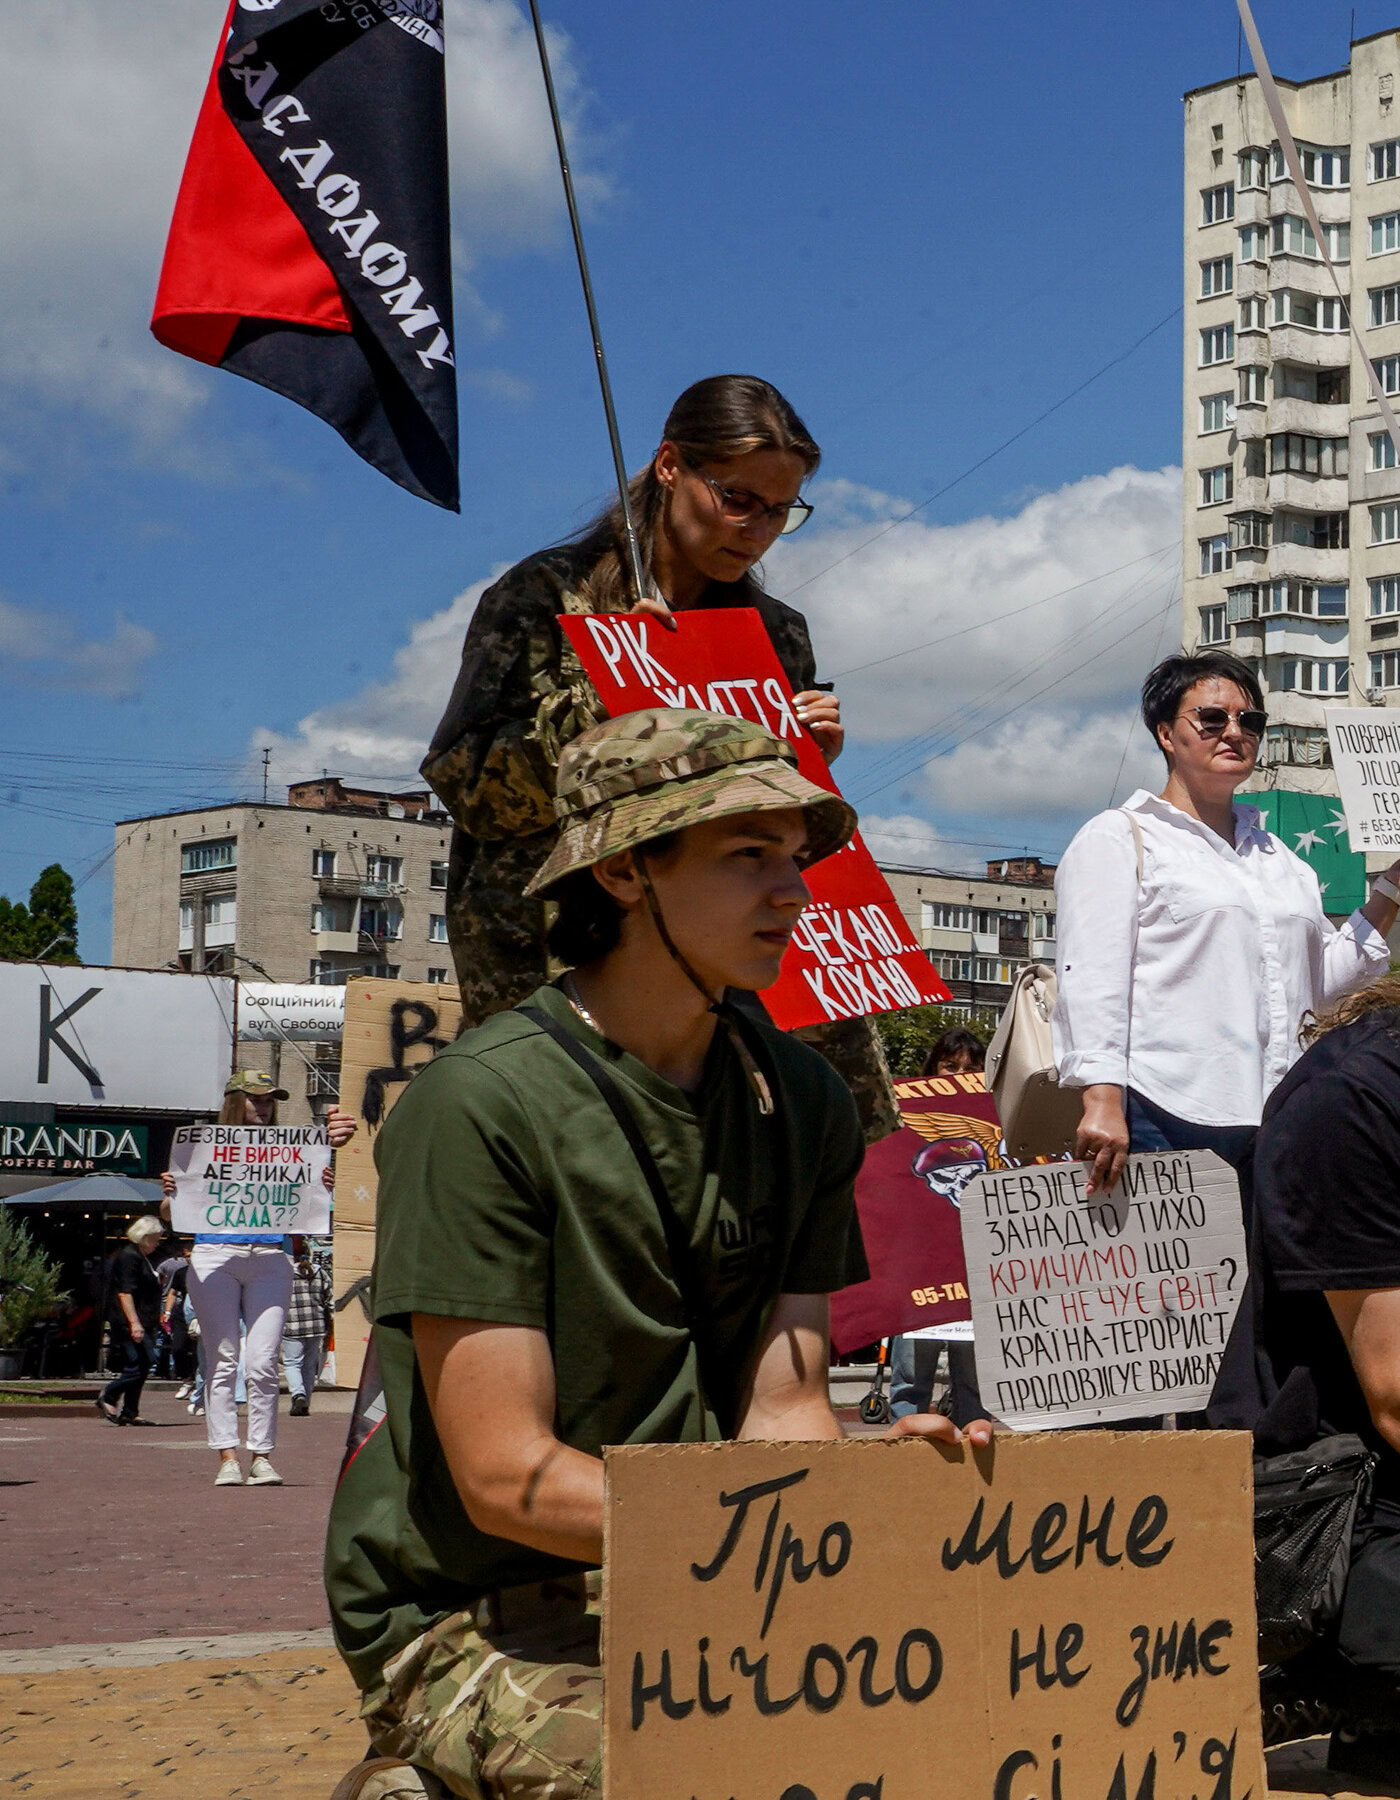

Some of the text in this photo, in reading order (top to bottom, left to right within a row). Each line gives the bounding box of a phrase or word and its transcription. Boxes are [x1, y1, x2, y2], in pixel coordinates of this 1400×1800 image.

[278, 137, 455, 370] ДОДОМУ
[584, 616, 678, 688] РІК
[245, 994, 337, 1009] ОФІЦІЙНИЙ
[62, 1159, 95, 1170] BAR
[202, 1163, 233, 1181] ДЕ
[212, 1145, 305, 1165] НЕ ВИРОК
[981, 1168, 1089, 1217] НЕВЖЕ
[1152, 1154, 1196, 1196] ВСІ
[985, 1194, 1206, 1257] ЗАНАДТО ТИХО
[910, 1281, 969, 1306] 95-ТА
[989, 1238, 1191, 1298] КРИЧИМО ЩО
[996, 1295, 1050, 1333] НАС
[1060, 1290, 1095, 1325] НЕ
[1097, 1281, 1151, 1317] ЧУЄ
[1000, 1311, 1230, 1370] КРАЇНА-ТЕРОРИСТ
[996, 1360, 1146, 1412] ПРОДОВЖУЄ
[690, 1467, 1176, 1640] Про мене
[630, 1616, 1236, 1732] нічого не знає
